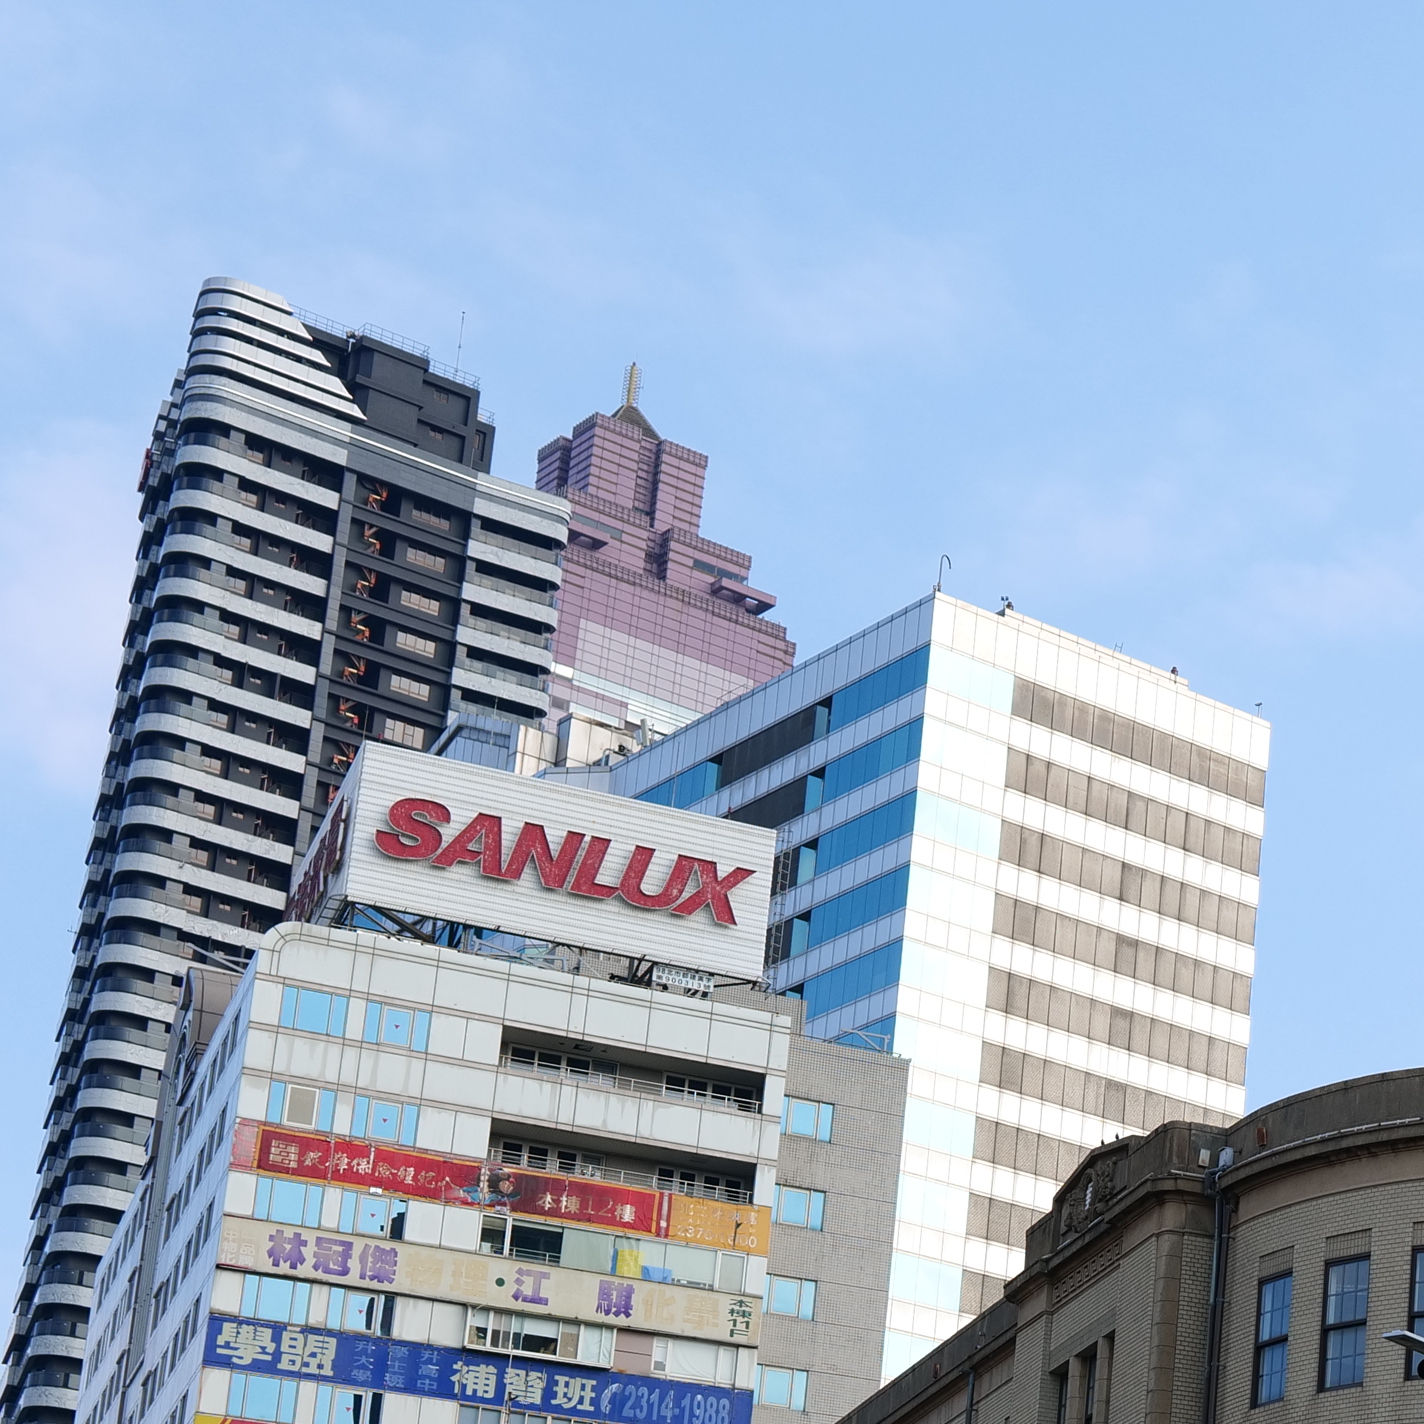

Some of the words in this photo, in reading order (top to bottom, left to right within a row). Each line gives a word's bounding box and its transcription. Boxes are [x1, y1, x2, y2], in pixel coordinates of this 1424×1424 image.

[374, 797, 757, 926] SANLUX
[536, 1192, 636, 1224] 本棟12樓
[216, 1322, 337, 1377] 學盟
[450, 1360, 597, 1412] 補習班
[351, 1340, 374, 1382] 升大學
[417, 1350, 440, 1392] 升高中
